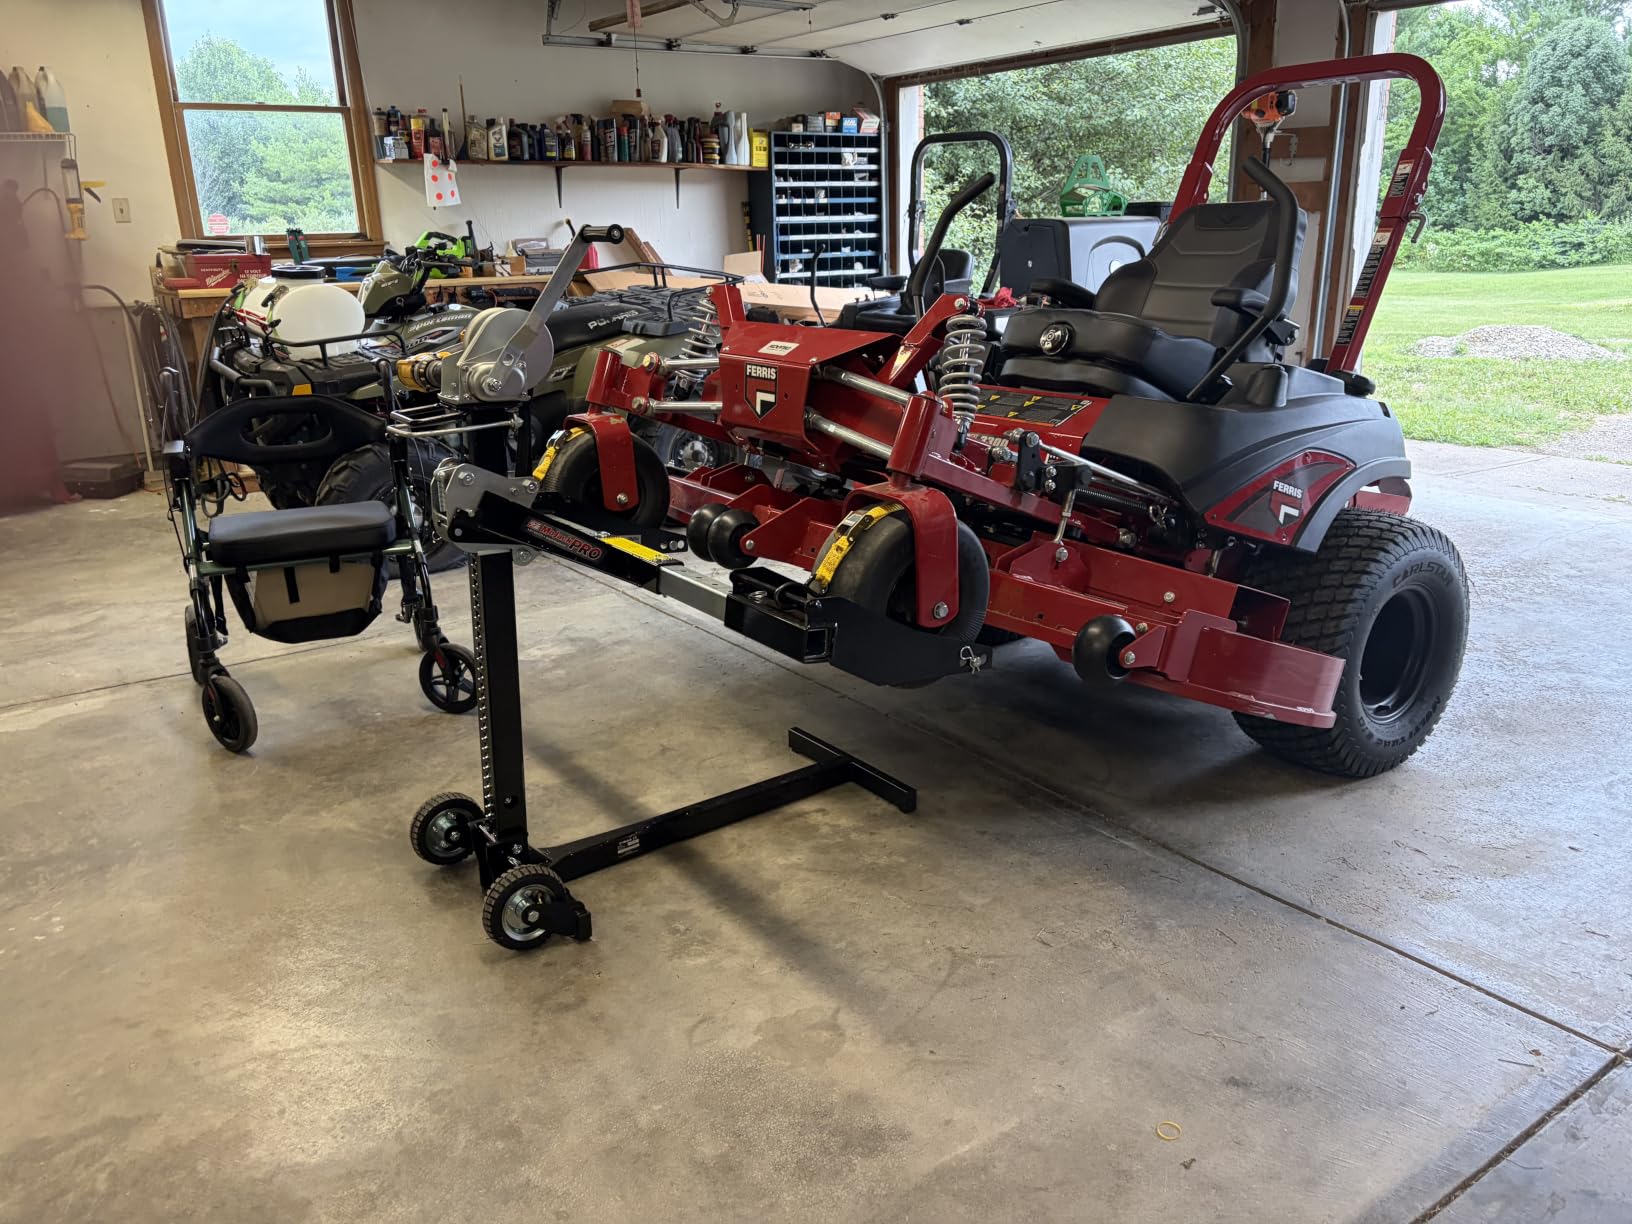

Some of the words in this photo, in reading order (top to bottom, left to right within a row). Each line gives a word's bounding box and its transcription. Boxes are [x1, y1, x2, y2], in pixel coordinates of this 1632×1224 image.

[746, 364, 776, 380] FERRIS
[1273, 480, 1302, 498] FERRIS
[569, 538, 602, 560] PRO
[1393, 561, 1454, 587] CARLSTAR
